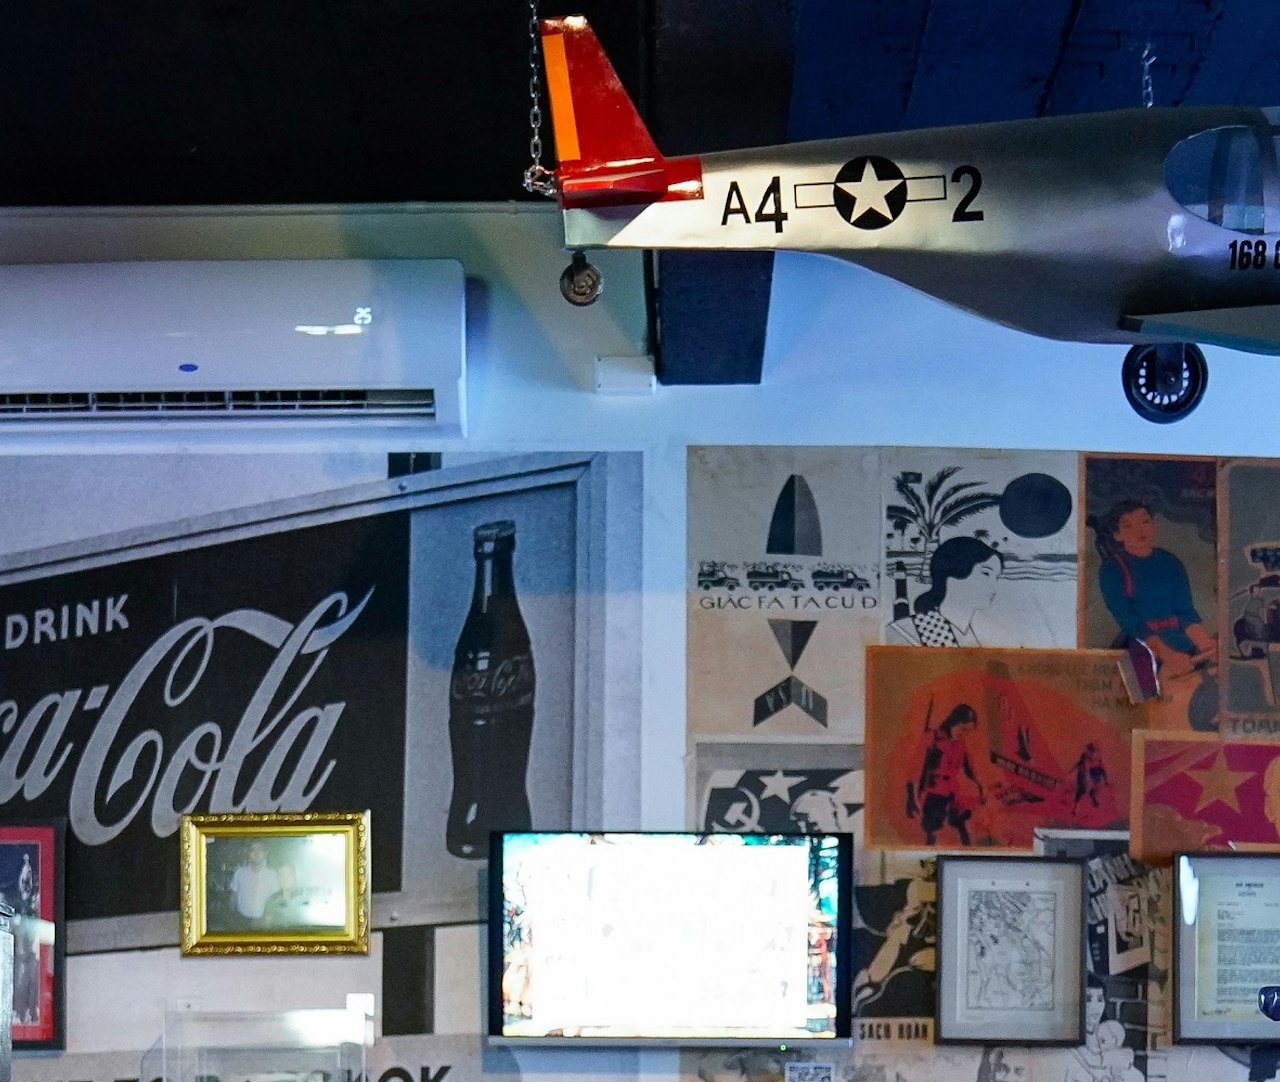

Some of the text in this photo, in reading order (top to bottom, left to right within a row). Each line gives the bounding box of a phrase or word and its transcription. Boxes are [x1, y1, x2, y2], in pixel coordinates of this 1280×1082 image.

[721, 165, 985, 233] A4 2
[1229, 239, 1268, 270] 168
[4, 593, 131, 650] DRINK
